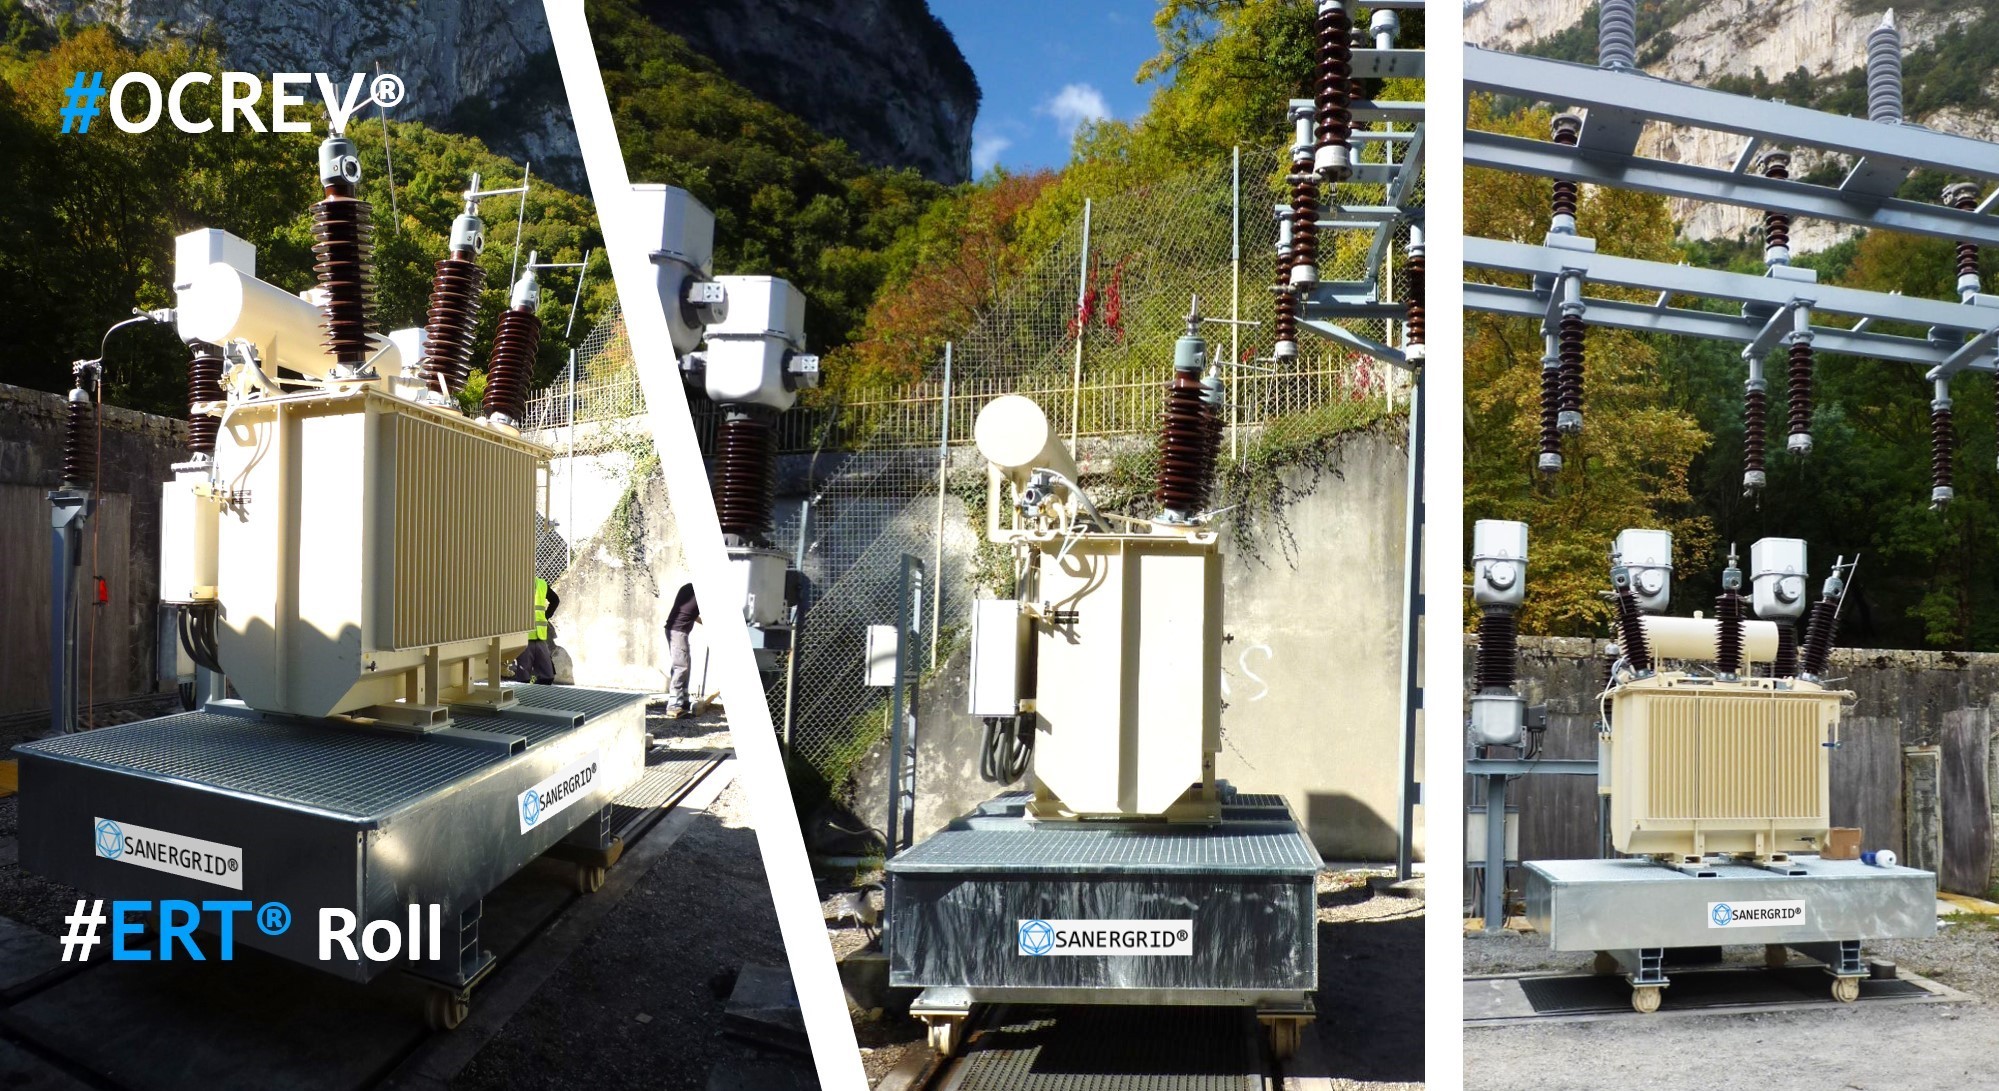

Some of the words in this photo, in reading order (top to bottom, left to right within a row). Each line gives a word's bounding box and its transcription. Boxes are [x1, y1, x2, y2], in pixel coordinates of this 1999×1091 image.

[539, 762, 597, 812] SANERGRID®
[124, 836, 239, 876] SANERGRID®
[1731, 907, 1802, 921] SANERGRID®
[1055, 929, 1189, 949] SANERGRID®
